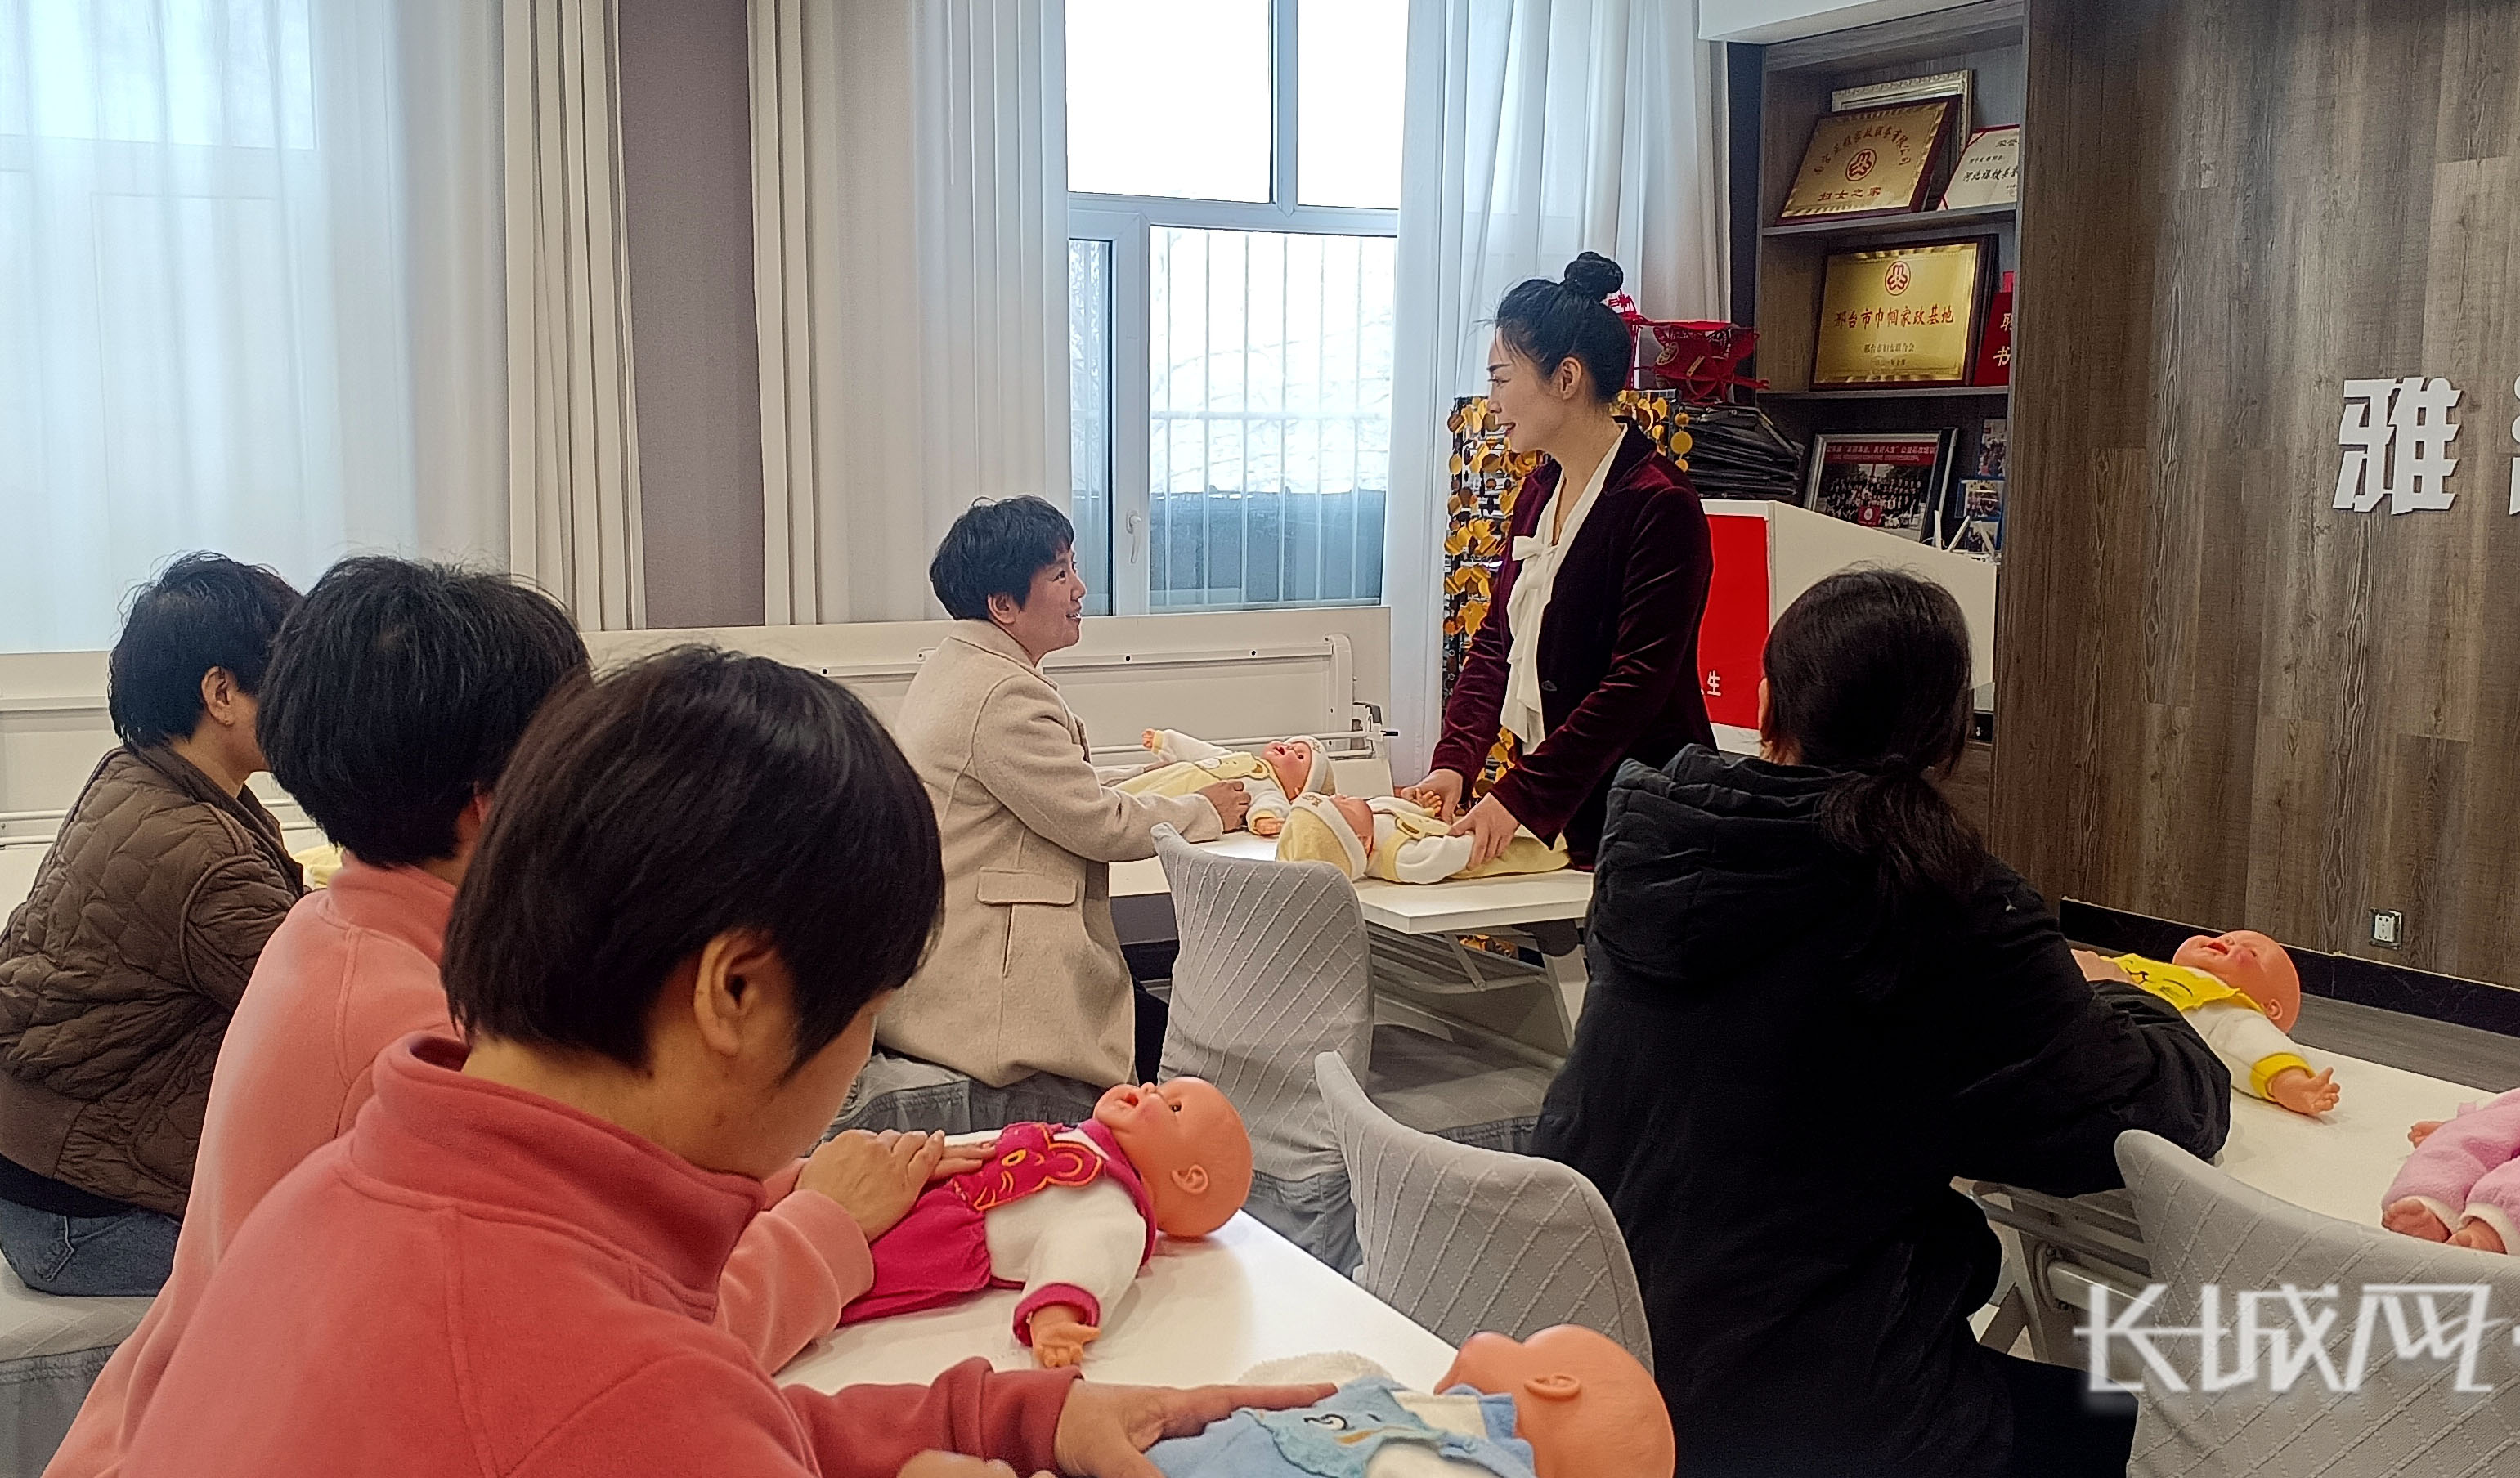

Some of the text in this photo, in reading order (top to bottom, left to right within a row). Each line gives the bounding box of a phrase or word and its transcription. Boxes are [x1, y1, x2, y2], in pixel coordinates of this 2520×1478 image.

[1834, 303, 1954, 329] 邢台市巾帼家政基地
[2333, 377, 2520, 515] 雅
[1701, 670, 1721, 696] 生
